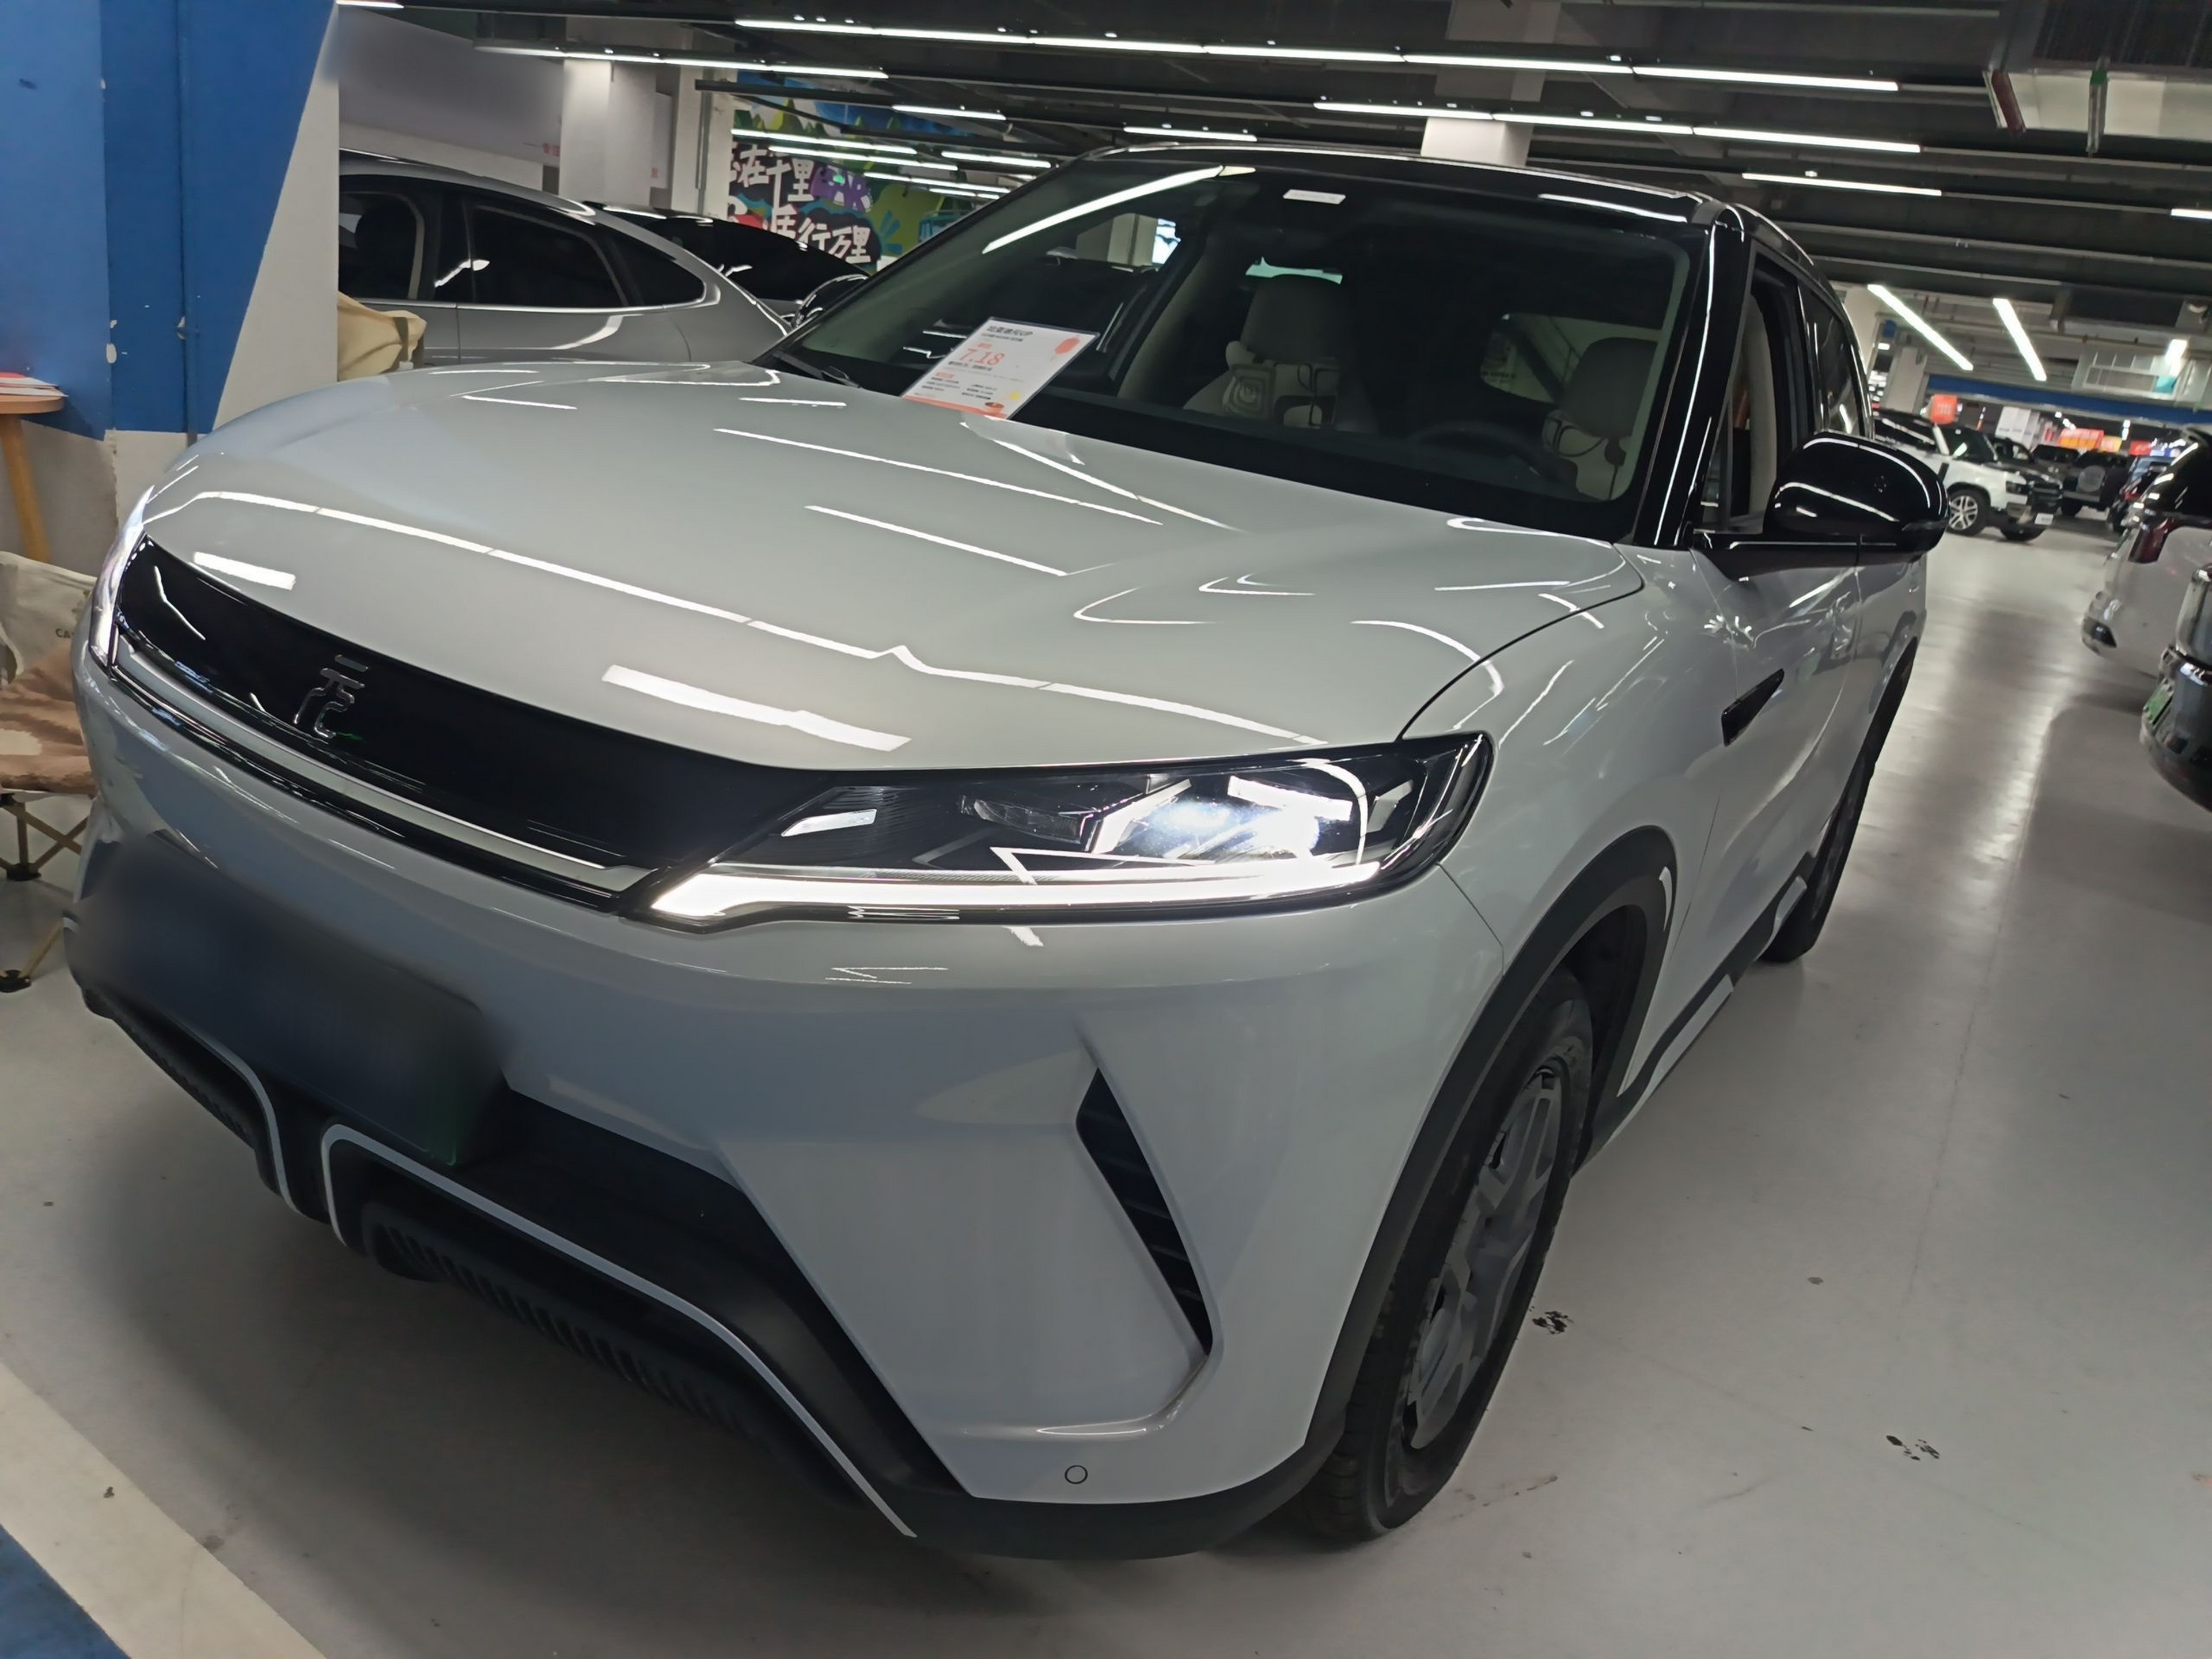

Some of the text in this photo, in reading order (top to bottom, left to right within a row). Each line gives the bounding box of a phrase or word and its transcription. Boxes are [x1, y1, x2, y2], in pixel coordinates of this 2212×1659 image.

[729, 142, 815, 206] 在千里
[960, 348, 1006, 366] 7.18
